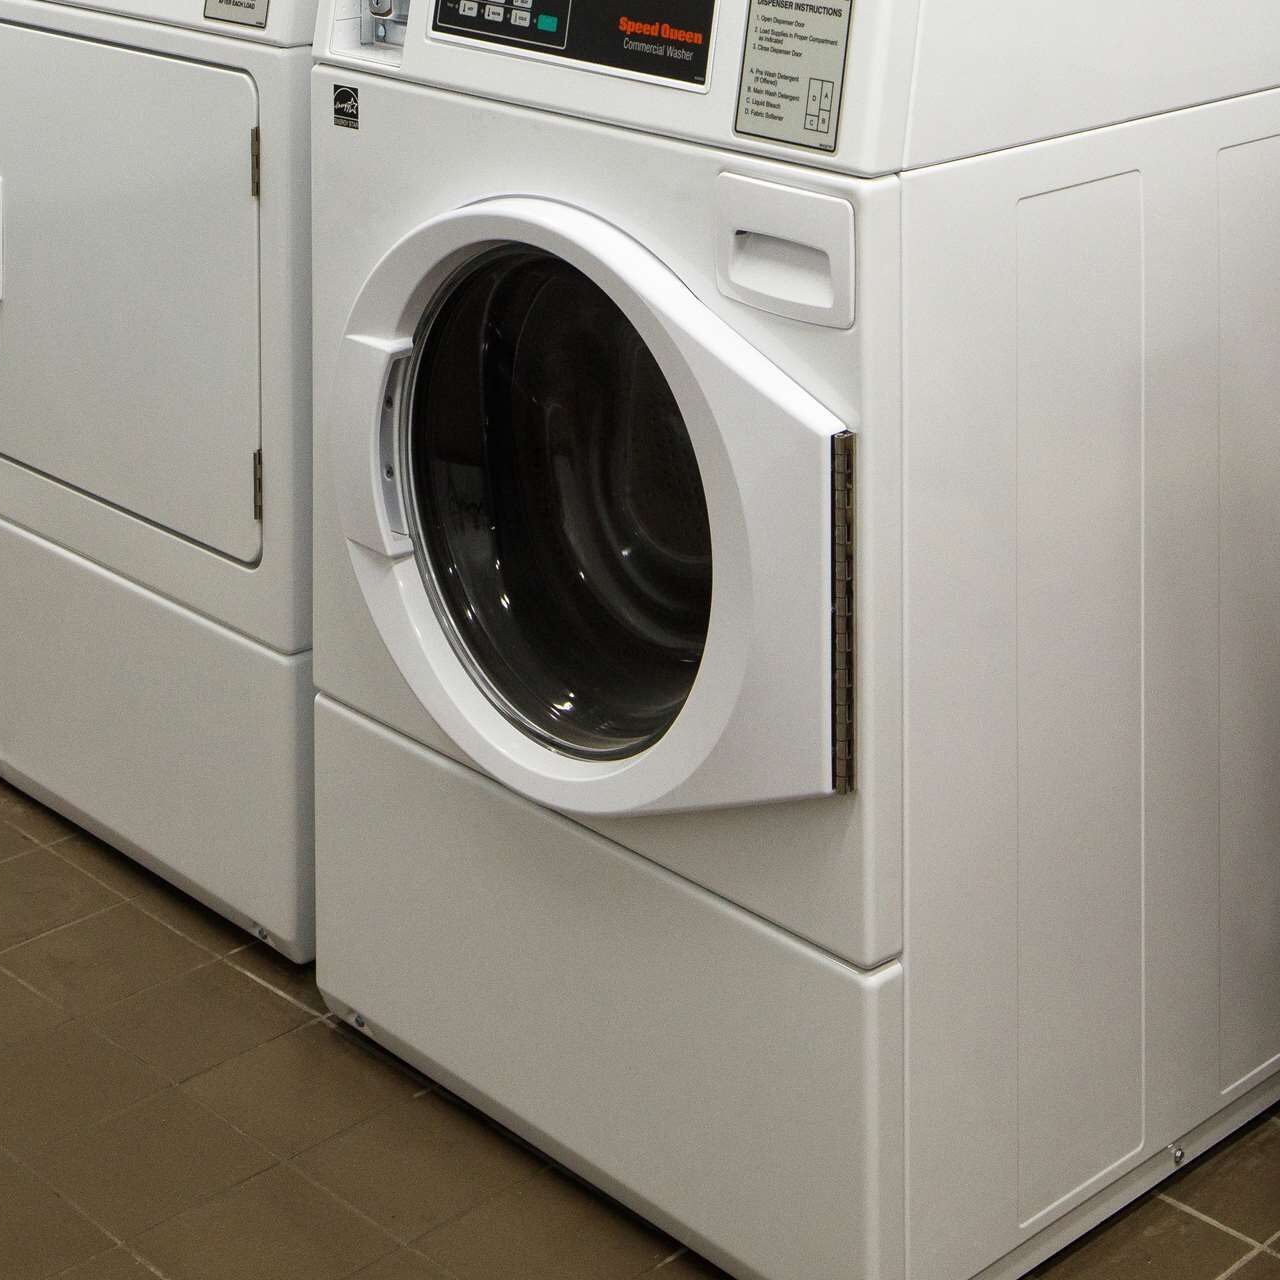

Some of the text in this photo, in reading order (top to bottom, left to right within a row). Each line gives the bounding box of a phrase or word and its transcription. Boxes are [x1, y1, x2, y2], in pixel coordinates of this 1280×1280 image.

[243, 2, 255, 10] LOAD
[794, 3, 842, 18] INSTRUCTIONS
[619, 16, 703, 45] Speed Queen
[623, 37, 694, 61] Commercial Washer
